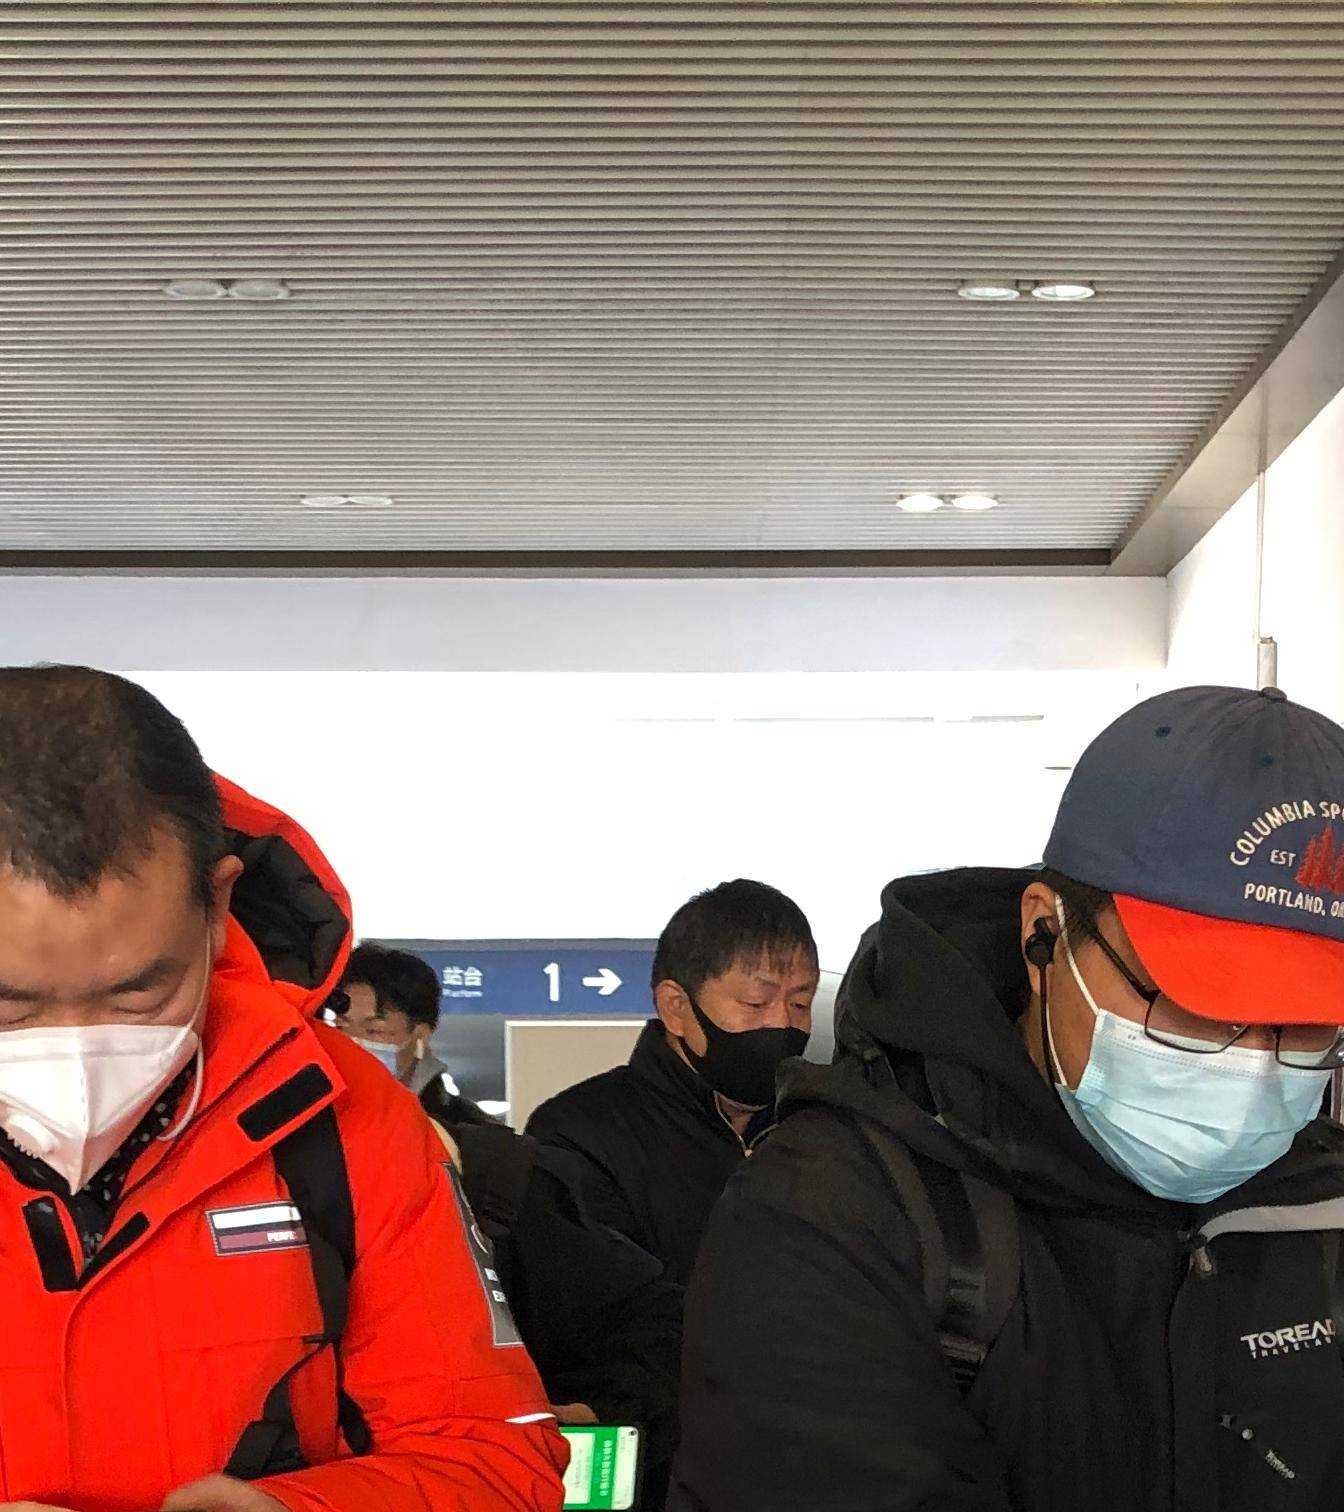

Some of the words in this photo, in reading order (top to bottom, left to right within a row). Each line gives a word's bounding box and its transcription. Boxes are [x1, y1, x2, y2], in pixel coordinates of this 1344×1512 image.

[1230, 800, 1316, 866] COLUMBIA
[1270, 849, 1296, 867] EST
[543, 962, 560, 1001] 1
